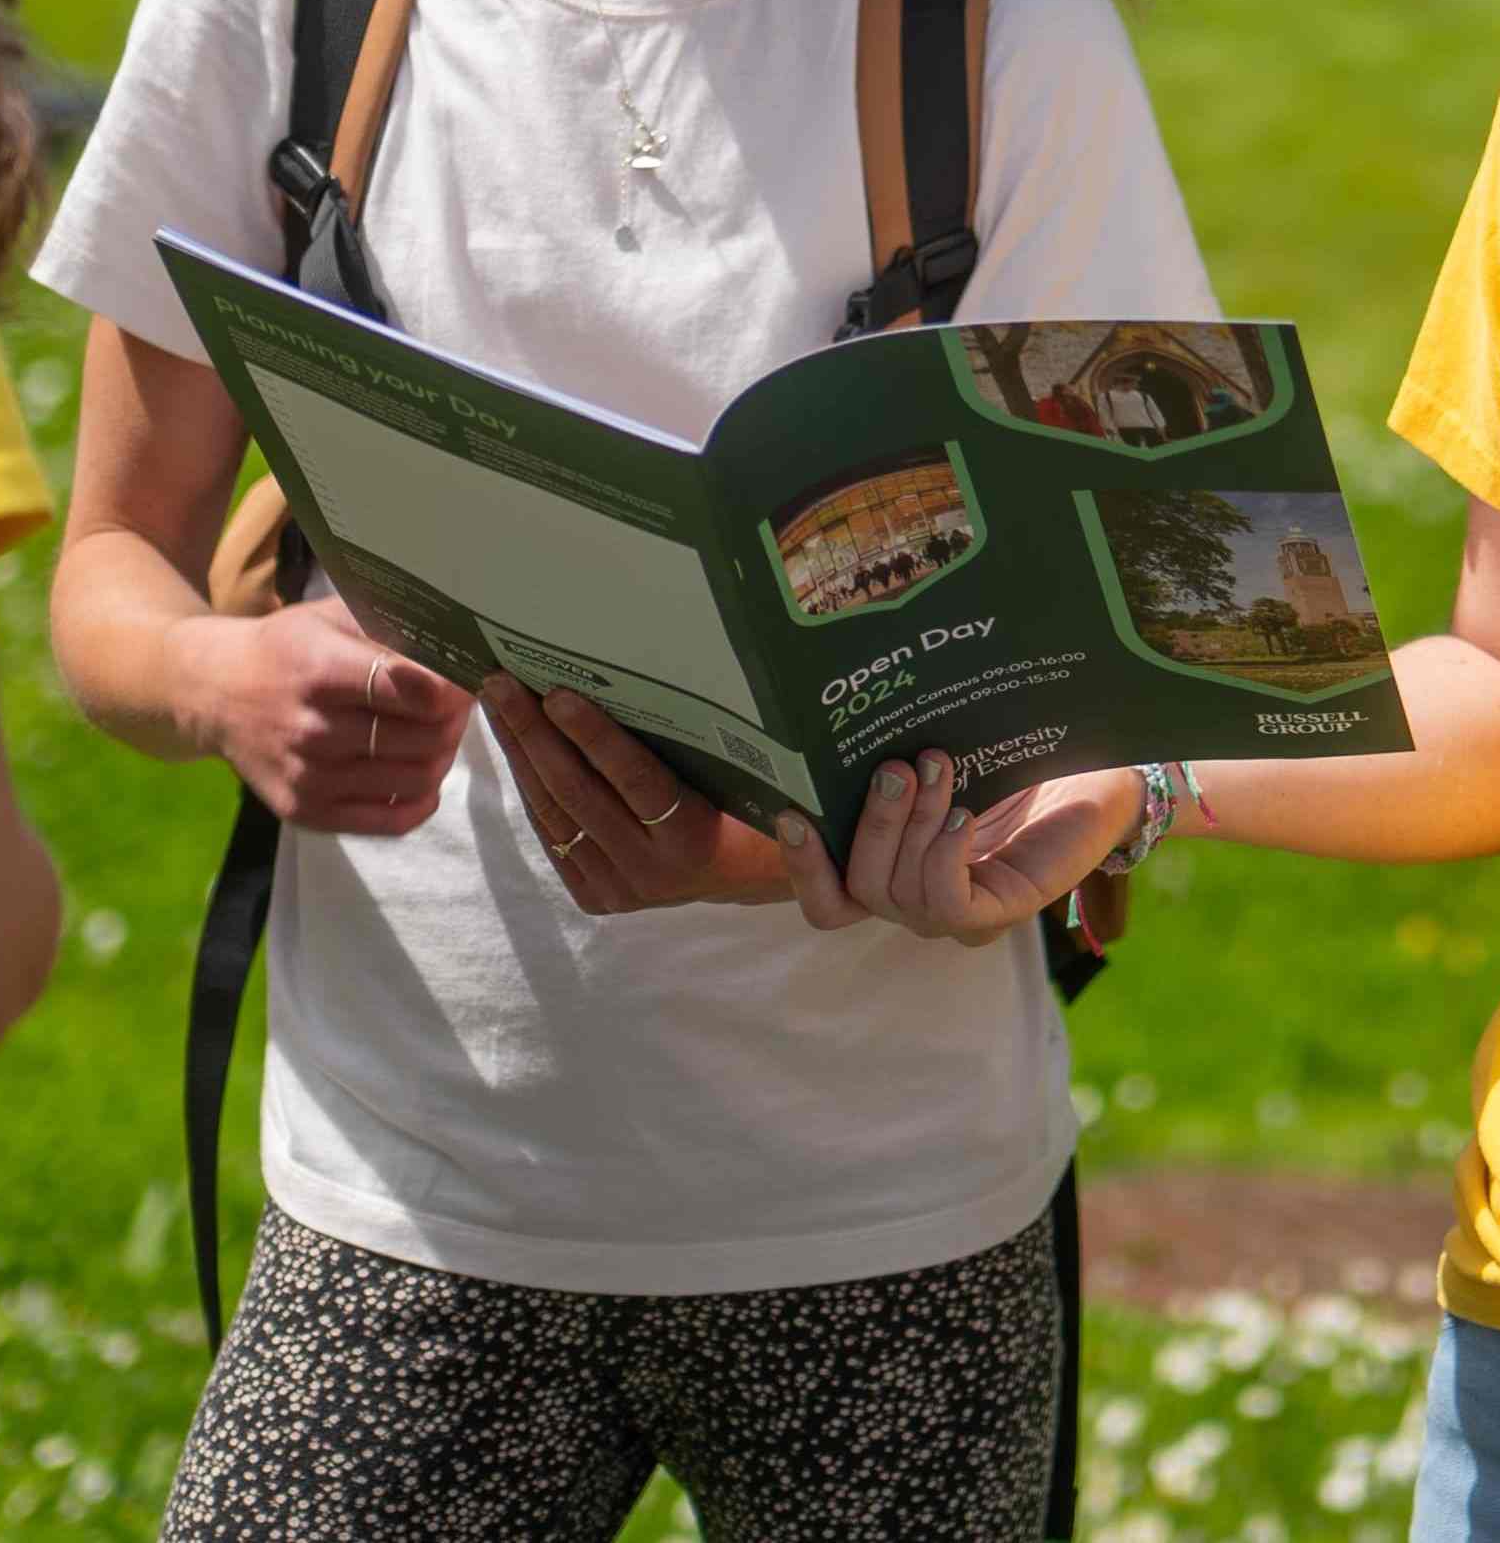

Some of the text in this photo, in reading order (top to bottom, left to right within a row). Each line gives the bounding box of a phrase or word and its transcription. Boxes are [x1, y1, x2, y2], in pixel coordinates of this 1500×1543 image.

[213, 295, 517, 439] Planning your Day
[821, 616, 997, 706] Open Day
[828, 668, 918, 733] 2024
[836, 702, 915, 753] Streatham
[916, 675, 981, 705] Campus
[841, 752, 857, 768] St
[904, 697, 968, 729] Campus
[1255, 711, 1370, 724] RUSSELL
[1257, 722, 1353, 735] GROUP
[976, 741, 1059, 777] Exeter
